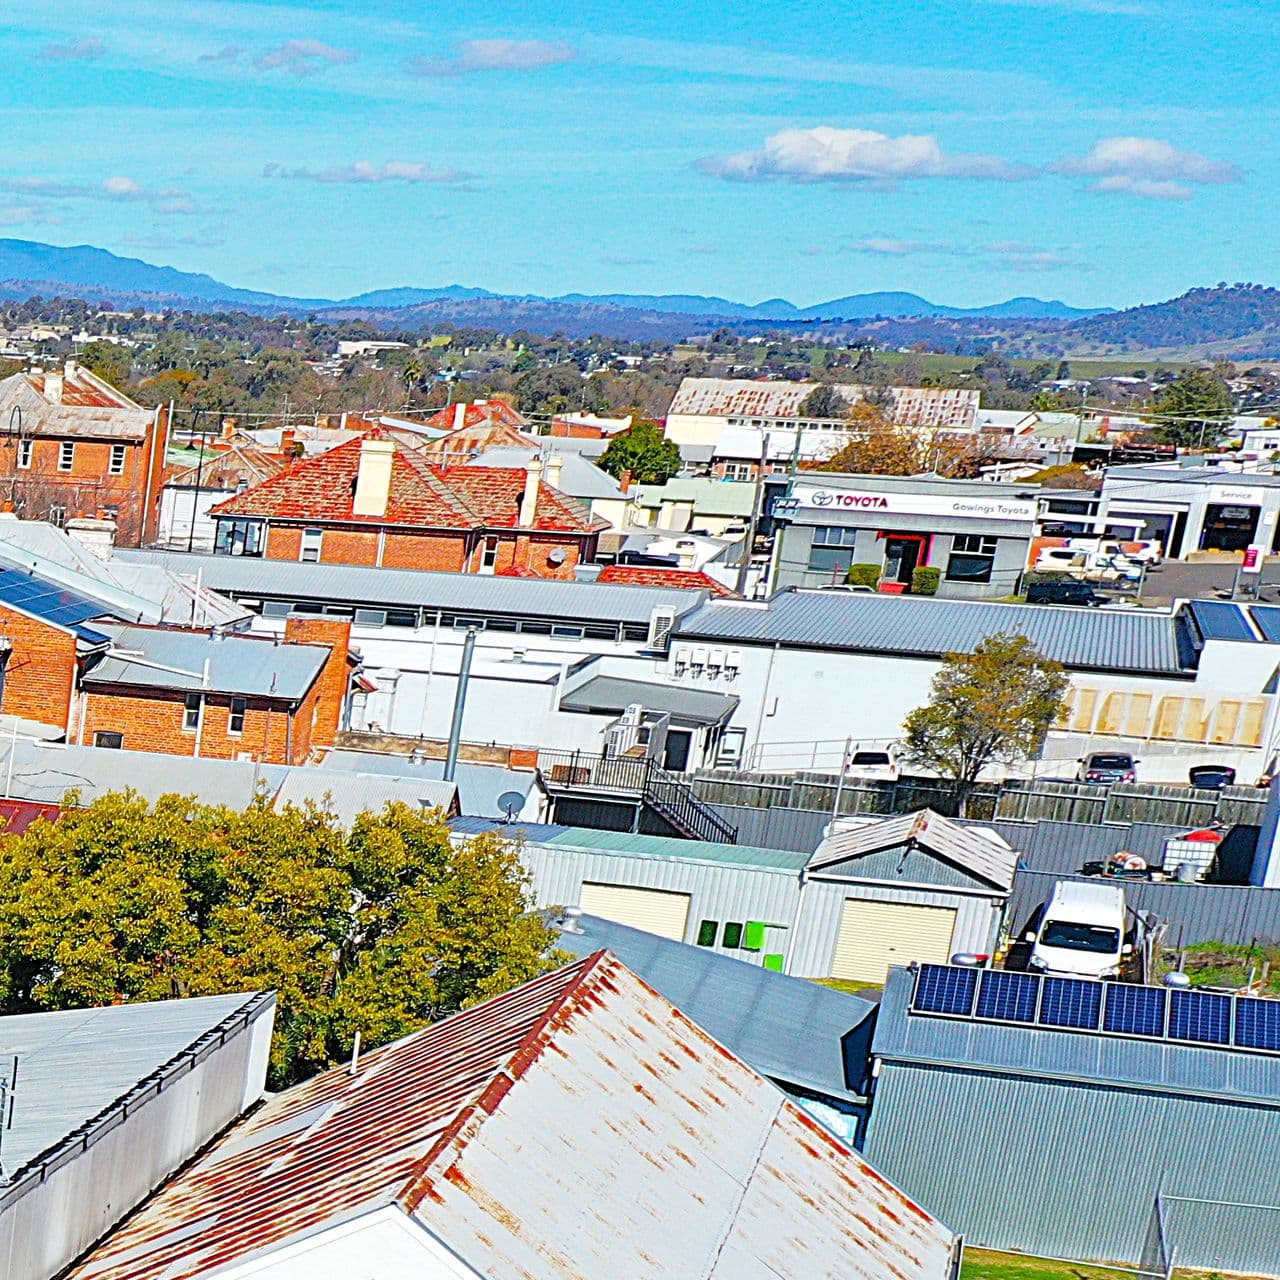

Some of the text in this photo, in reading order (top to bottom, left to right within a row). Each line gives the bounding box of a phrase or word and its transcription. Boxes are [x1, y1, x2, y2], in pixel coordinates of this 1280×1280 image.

[1221, 489, 1252, 499] Service
[836, 494, 889, 509] TOYOTA
[952, 503, 1029, 515] Gowings Toyota
